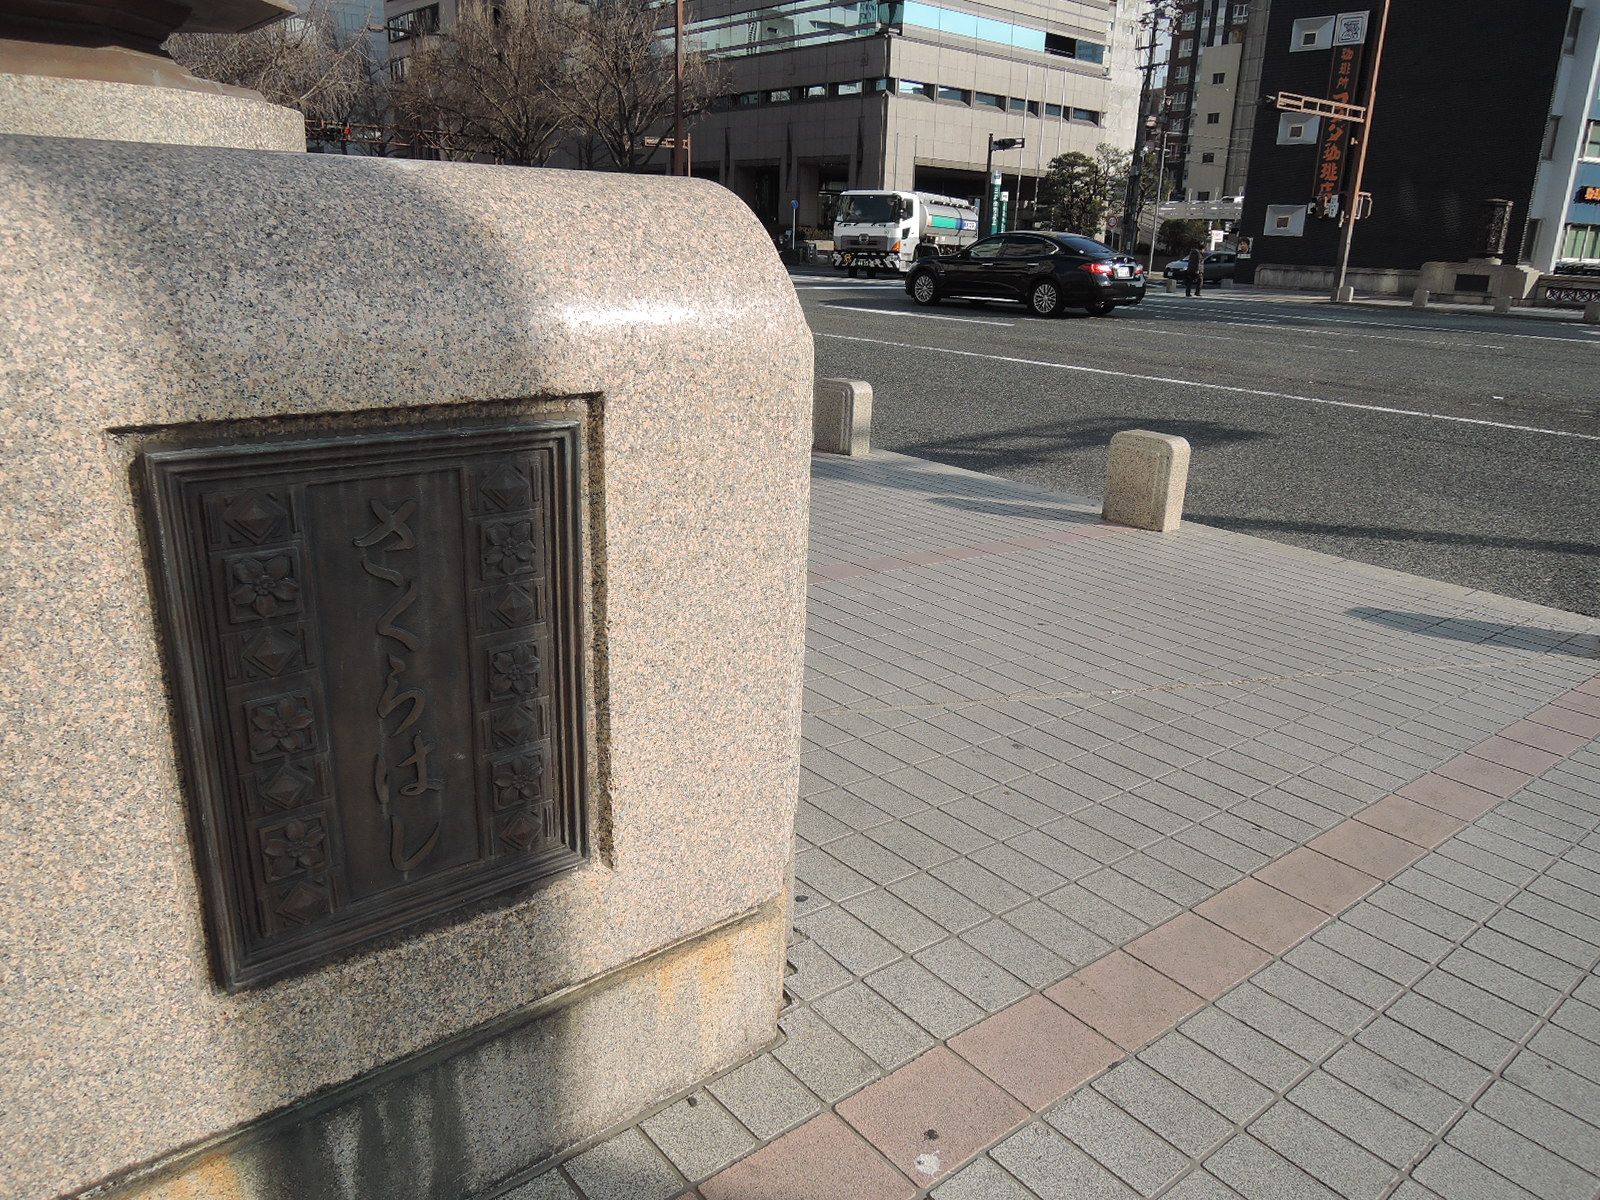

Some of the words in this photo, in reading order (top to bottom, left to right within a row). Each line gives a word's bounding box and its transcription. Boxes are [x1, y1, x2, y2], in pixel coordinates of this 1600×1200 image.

[353, 498, 445, 872] さくらはし
